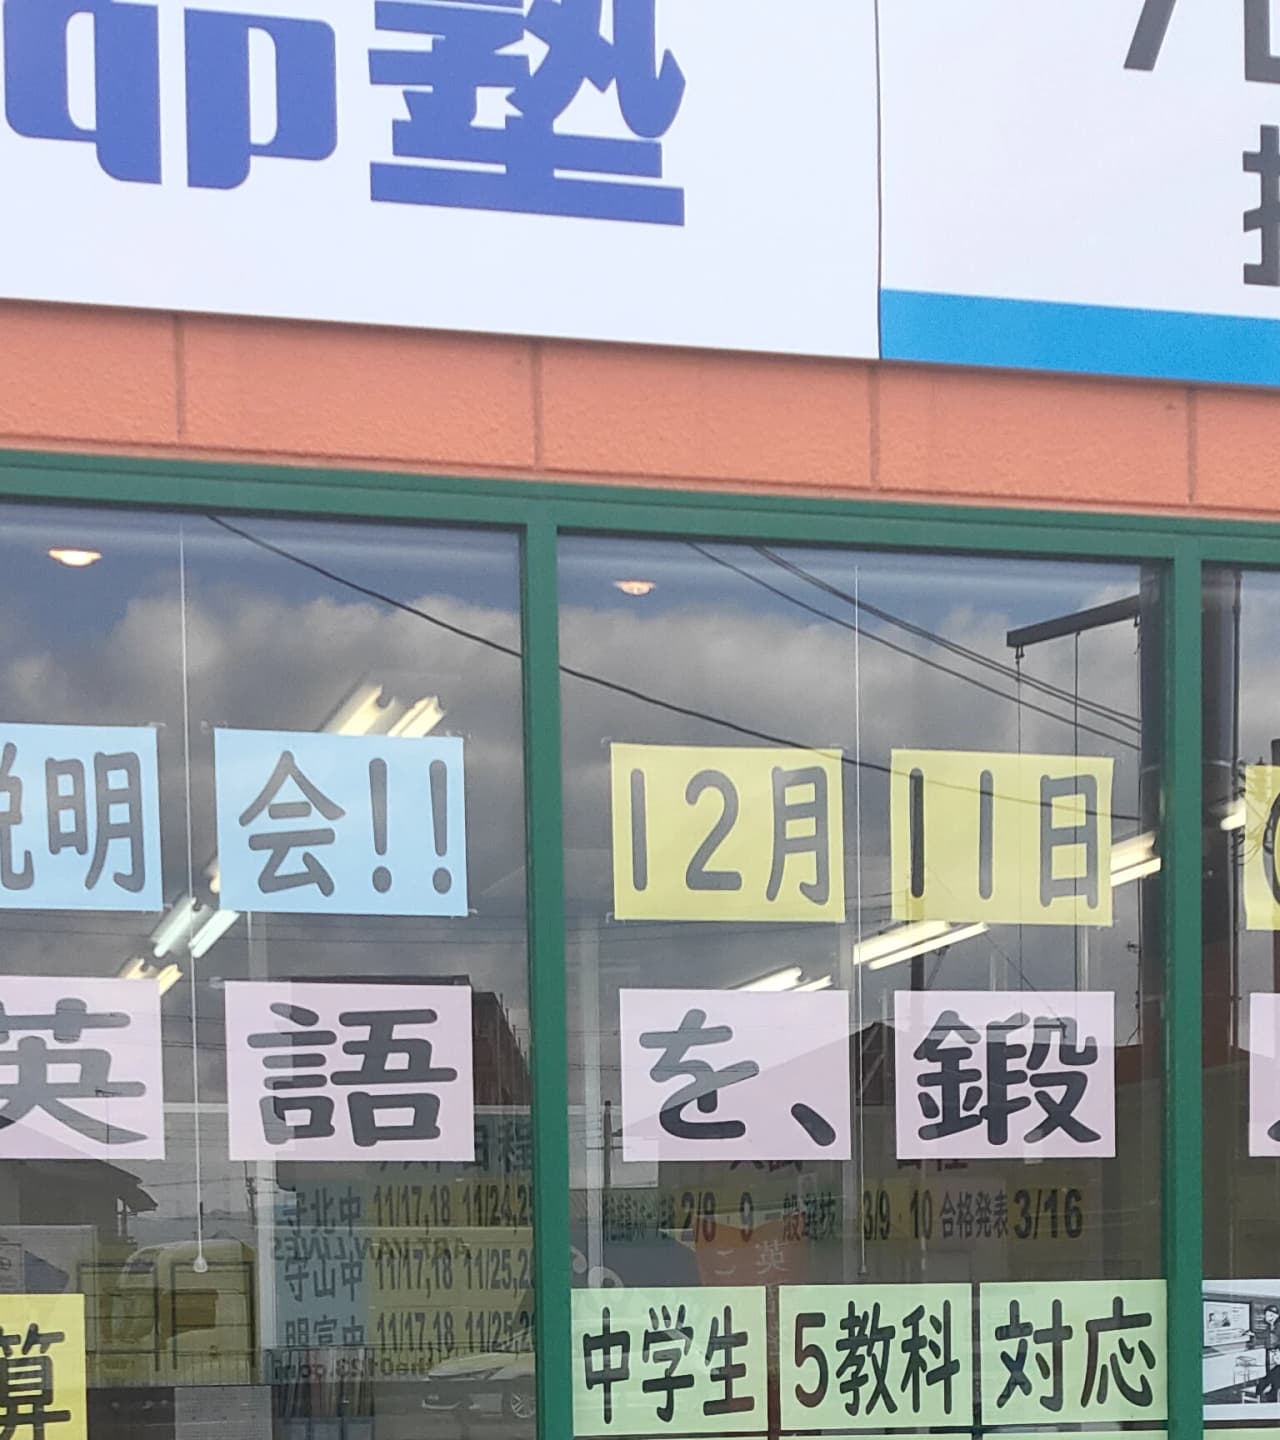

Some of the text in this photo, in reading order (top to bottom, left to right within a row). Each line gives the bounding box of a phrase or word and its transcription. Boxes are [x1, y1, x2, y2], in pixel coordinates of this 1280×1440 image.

[629, 766, 830, 906] 12月
[908, 767, 1099, 910] 11日
[462, 1185, 534, 1234] 11/24,2
[939, 1191, 1009, 1239] 合格発表
[1013, 1188, 1084, 1239] 3/16
[464, 1248, 534, 1297] 11/25,2
[465, 1311, 534, 1354] 11/25,2
[582, 1296, 1158, 1425] 中学生 5教科 対応
